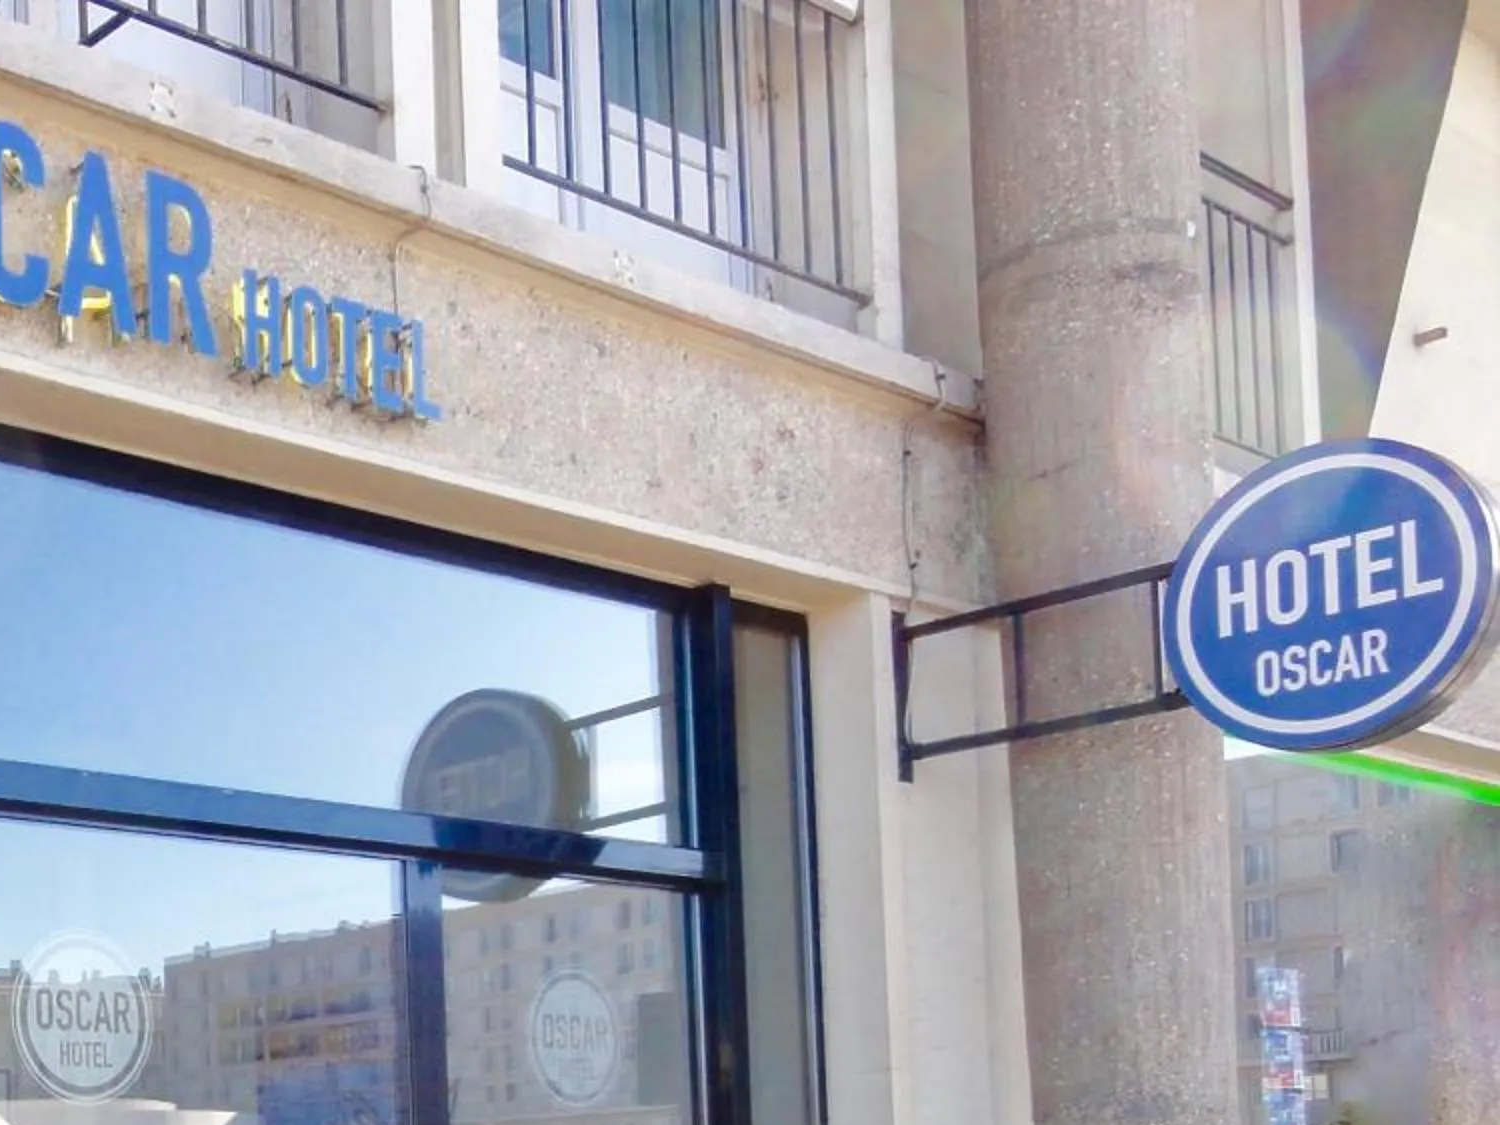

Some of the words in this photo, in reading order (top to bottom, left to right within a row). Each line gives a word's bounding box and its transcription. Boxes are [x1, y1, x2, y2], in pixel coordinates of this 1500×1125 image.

[235, 267, 441, 421] HOTEL
[1216, 519, 1445, 638] HOTEL
[1255, 629, 1390, 697] OSCAR
[35, 988, 132, 1035] OSCAR
[542, 1013, 608, 1053] OSCAR
[59, 1040, 114, 1069] HOTEL
